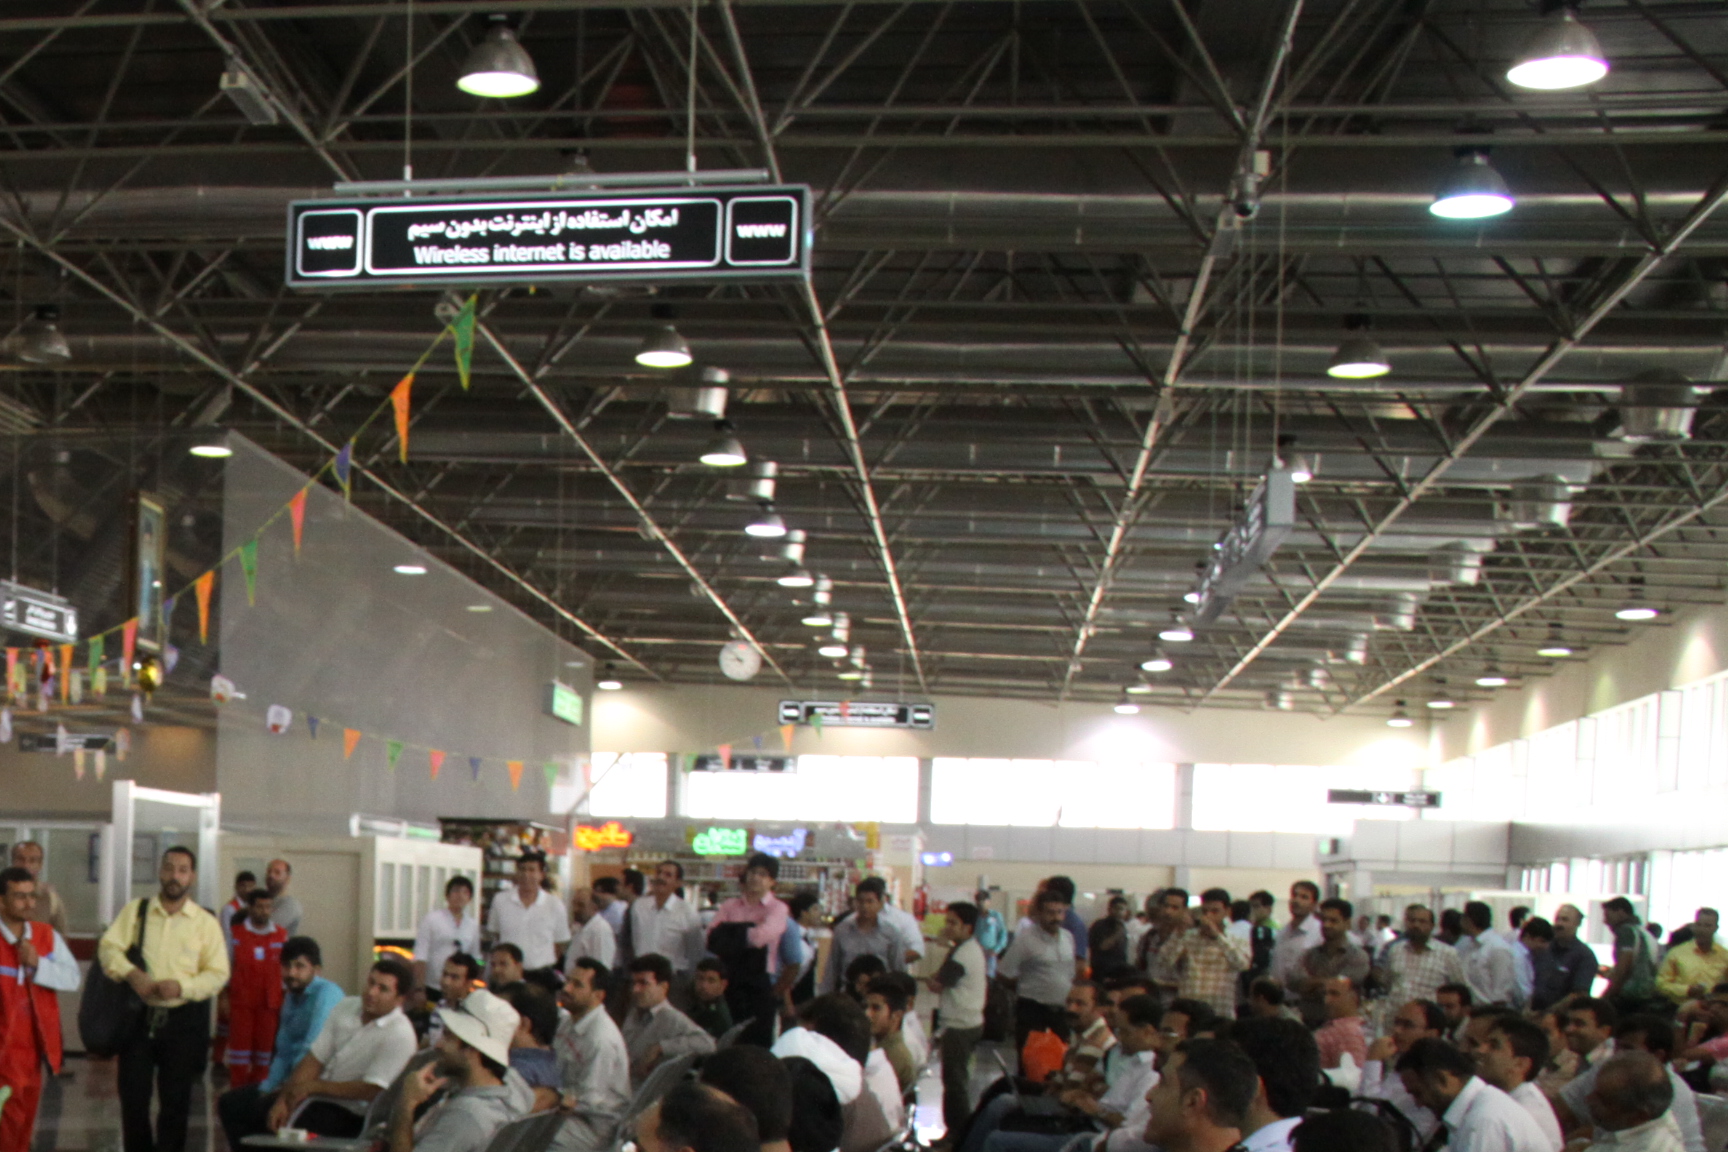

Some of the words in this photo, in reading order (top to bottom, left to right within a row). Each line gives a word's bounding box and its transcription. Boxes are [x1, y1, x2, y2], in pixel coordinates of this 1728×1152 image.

[406, 220, 446, 242] سیم
[444, 218, 488, 239] بدون
[488, 210, 551, 237] اینترنت
[550, 211, 568, 237] از
[568, 209, 630, 231] استفاده
[628, 207, 680, 234] امکان
[735, 223, 788, 239] www
[306, 234, 355, 250] www
[413, 245, 490, 265] Wireless
[493, 241, 567, 263] internet
[569, 242, 585, 261] is
[588, 238, 672, 262] available
